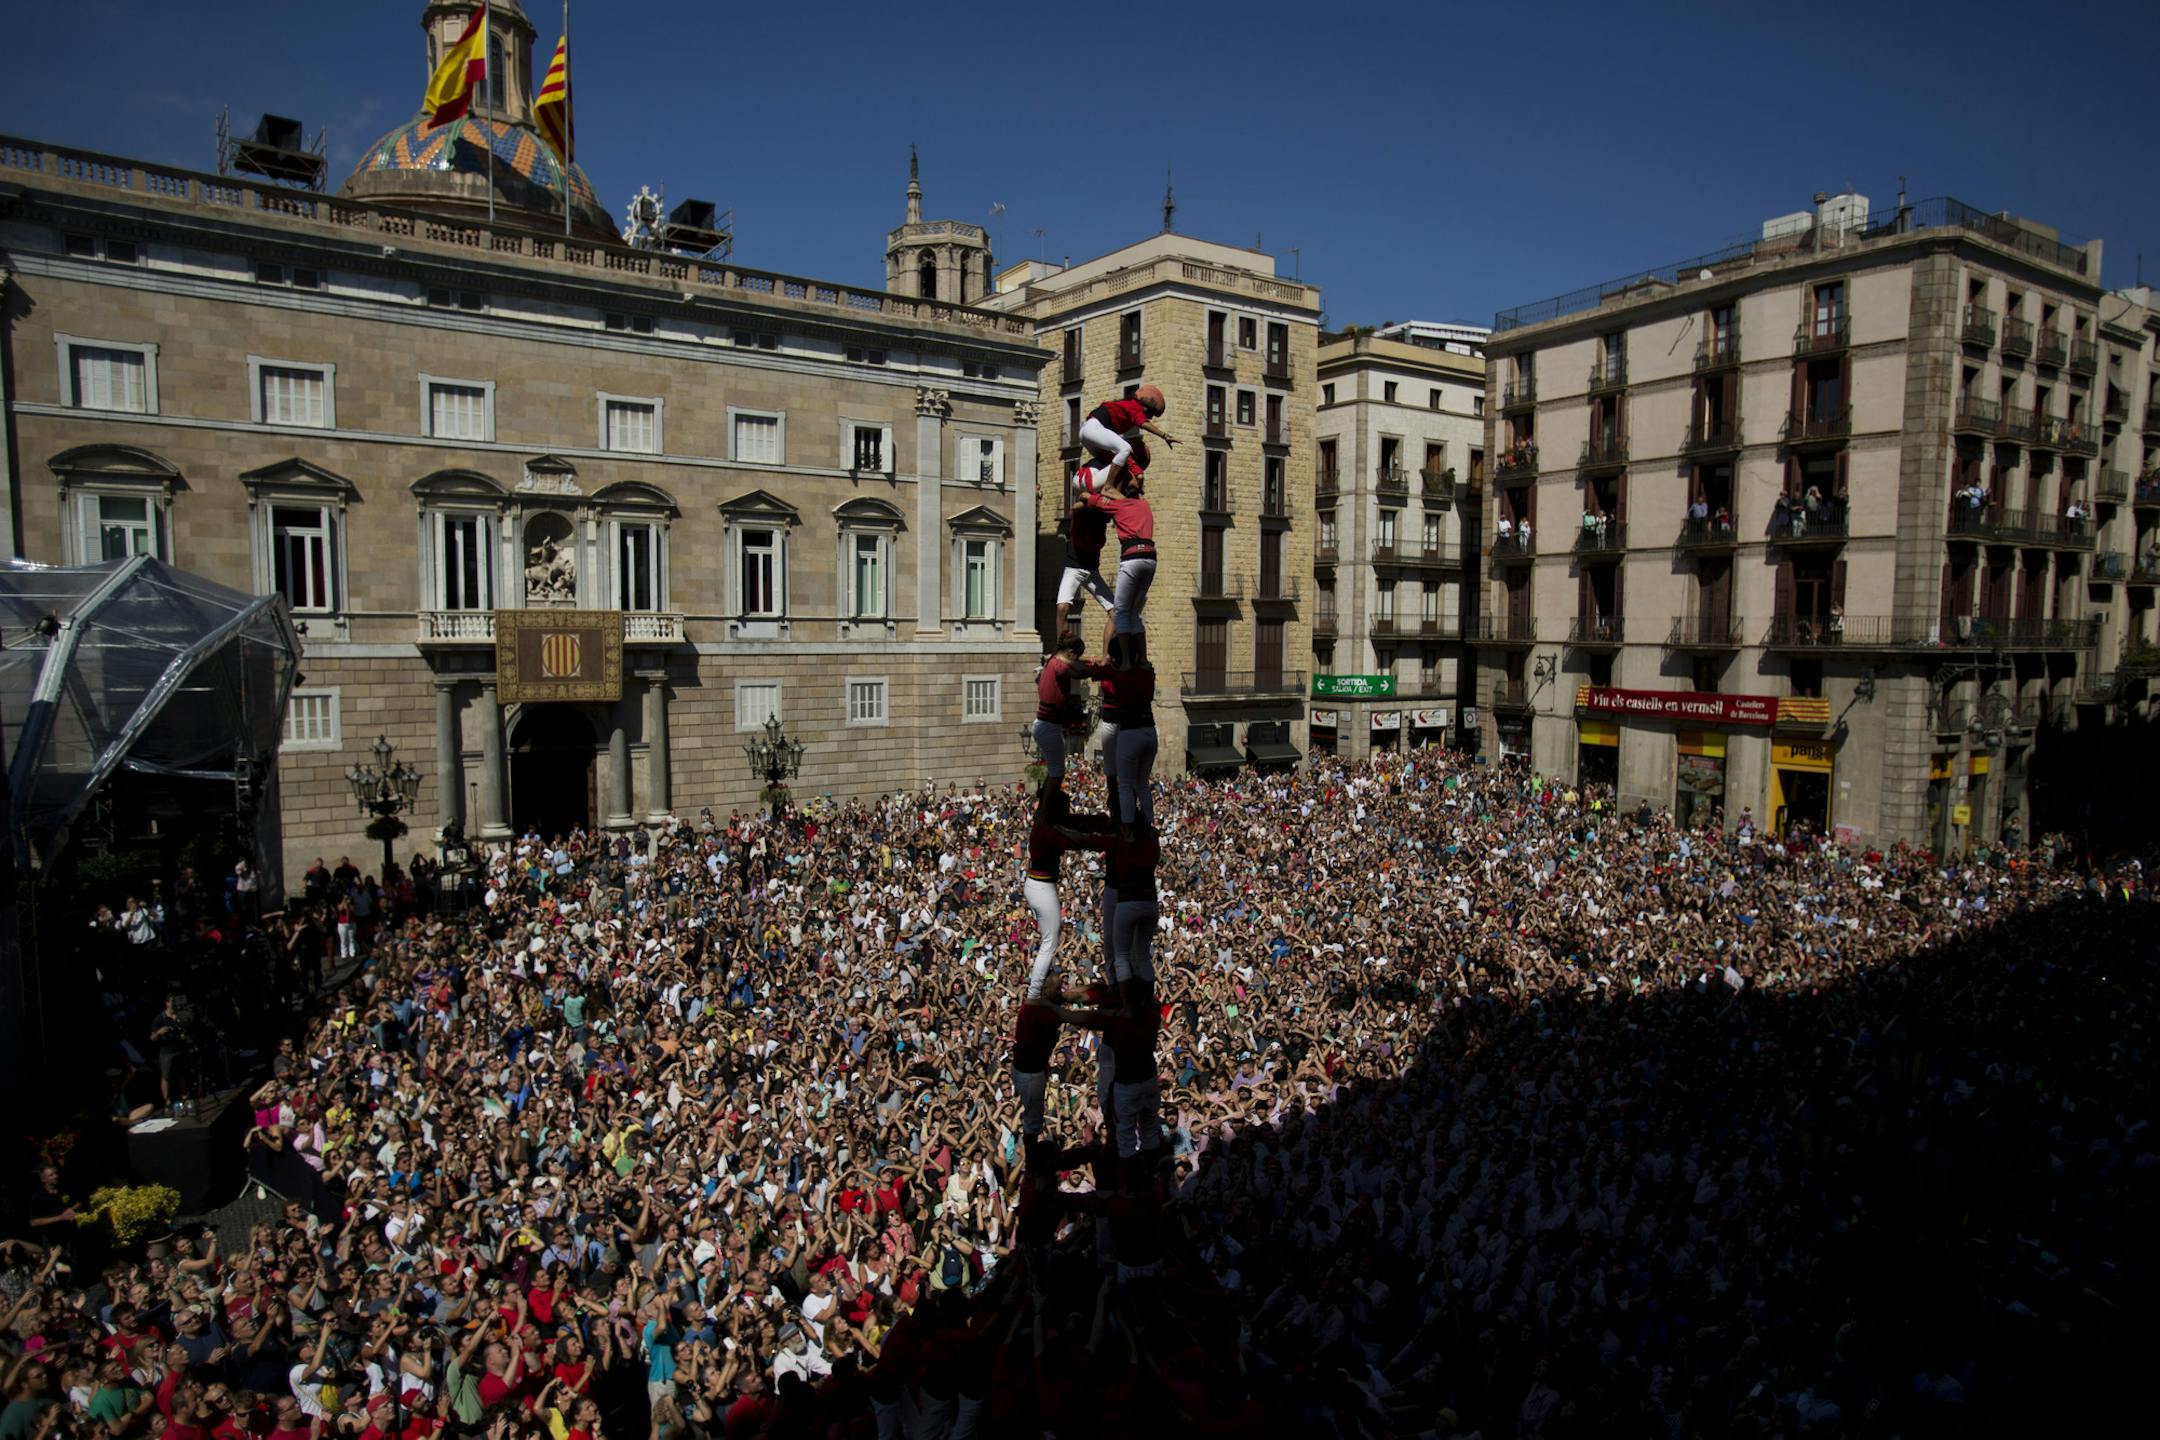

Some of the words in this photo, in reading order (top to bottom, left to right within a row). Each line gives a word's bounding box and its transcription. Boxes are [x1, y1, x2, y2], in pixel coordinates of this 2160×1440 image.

[1337, 678, 1367, 686] SORTIDA
[1594, 693, 1609, 706] Viu
[1612, 694, 1624, 707] els
[1626, 697, 1662, 711] castells
[1666, 701, 1678, 712] en
[1681, 701, 1723, 716] vermell
[1736, 700, 1765, 710] Castellers
[1730, 709, 1737, 718] de
[1738, 710, 1769, 720] Barcelona
